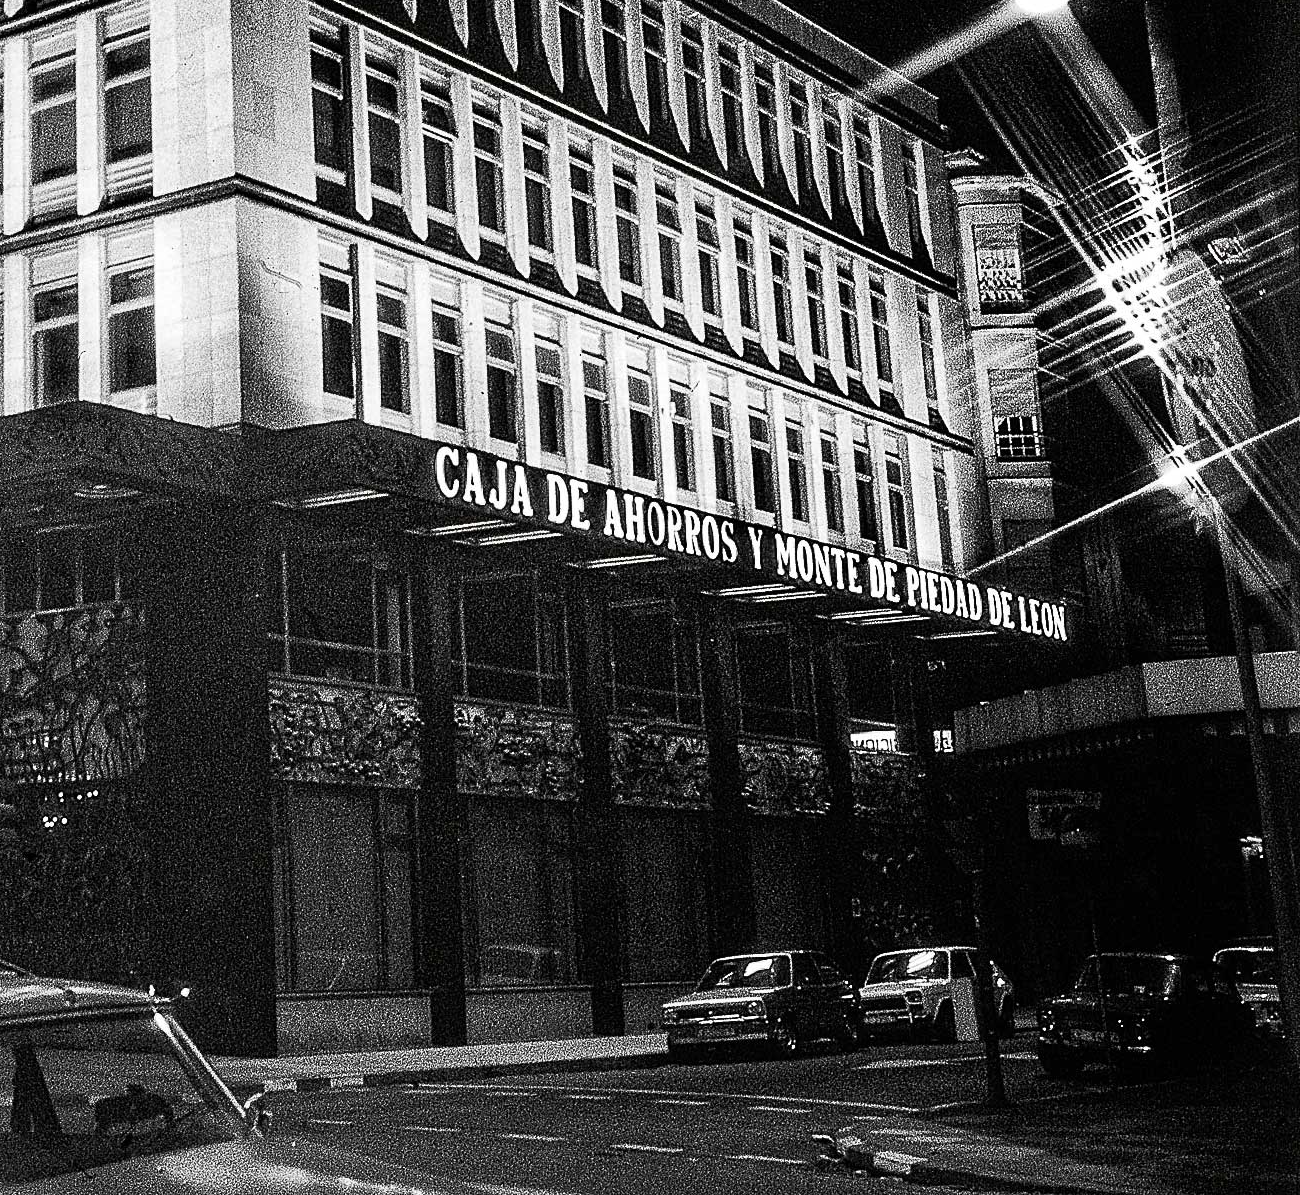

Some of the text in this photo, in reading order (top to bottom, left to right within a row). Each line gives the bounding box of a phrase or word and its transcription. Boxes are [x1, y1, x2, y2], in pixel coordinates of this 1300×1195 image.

[436, 447, 1067, 641] CAJA DE AHORROS Y MONTE DE PIEDAD DE LEON
